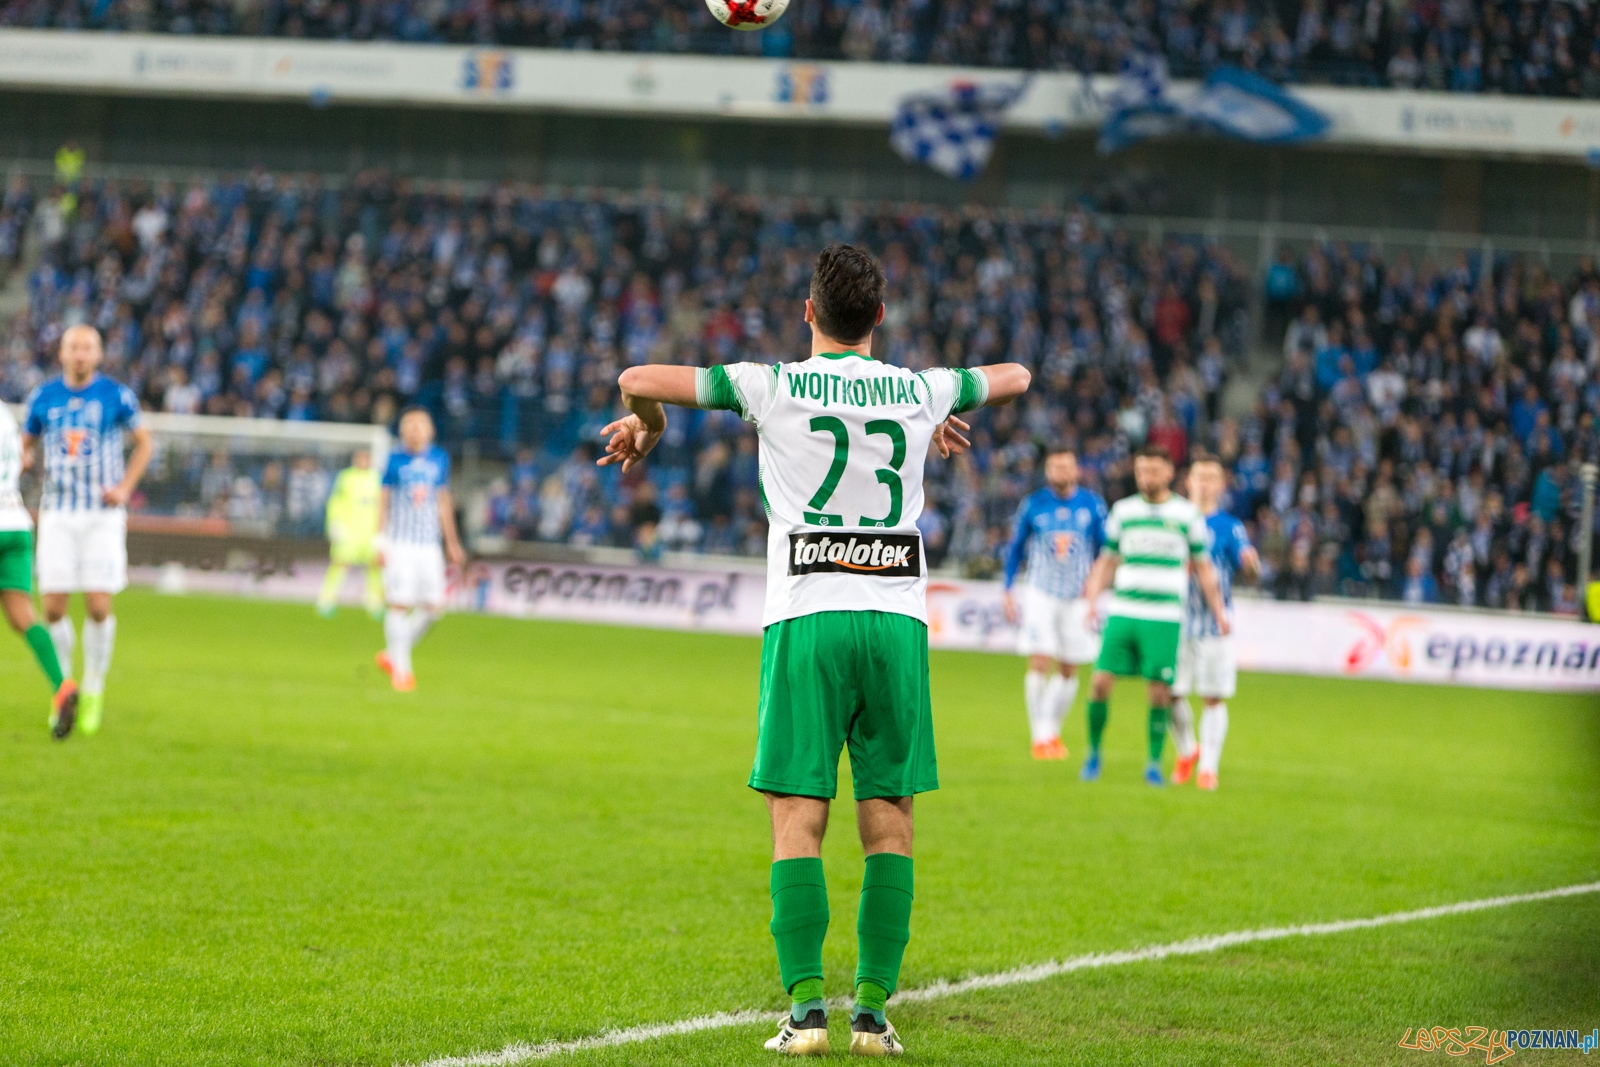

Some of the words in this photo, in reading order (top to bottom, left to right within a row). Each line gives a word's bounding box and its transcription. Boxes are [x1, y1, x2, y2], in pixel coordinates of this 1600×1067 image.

[787, 372, 920, 408] WOJTKOWIAK
[803, 415, 907, 528] 23
[794, 536, 912, 568] totolotek
